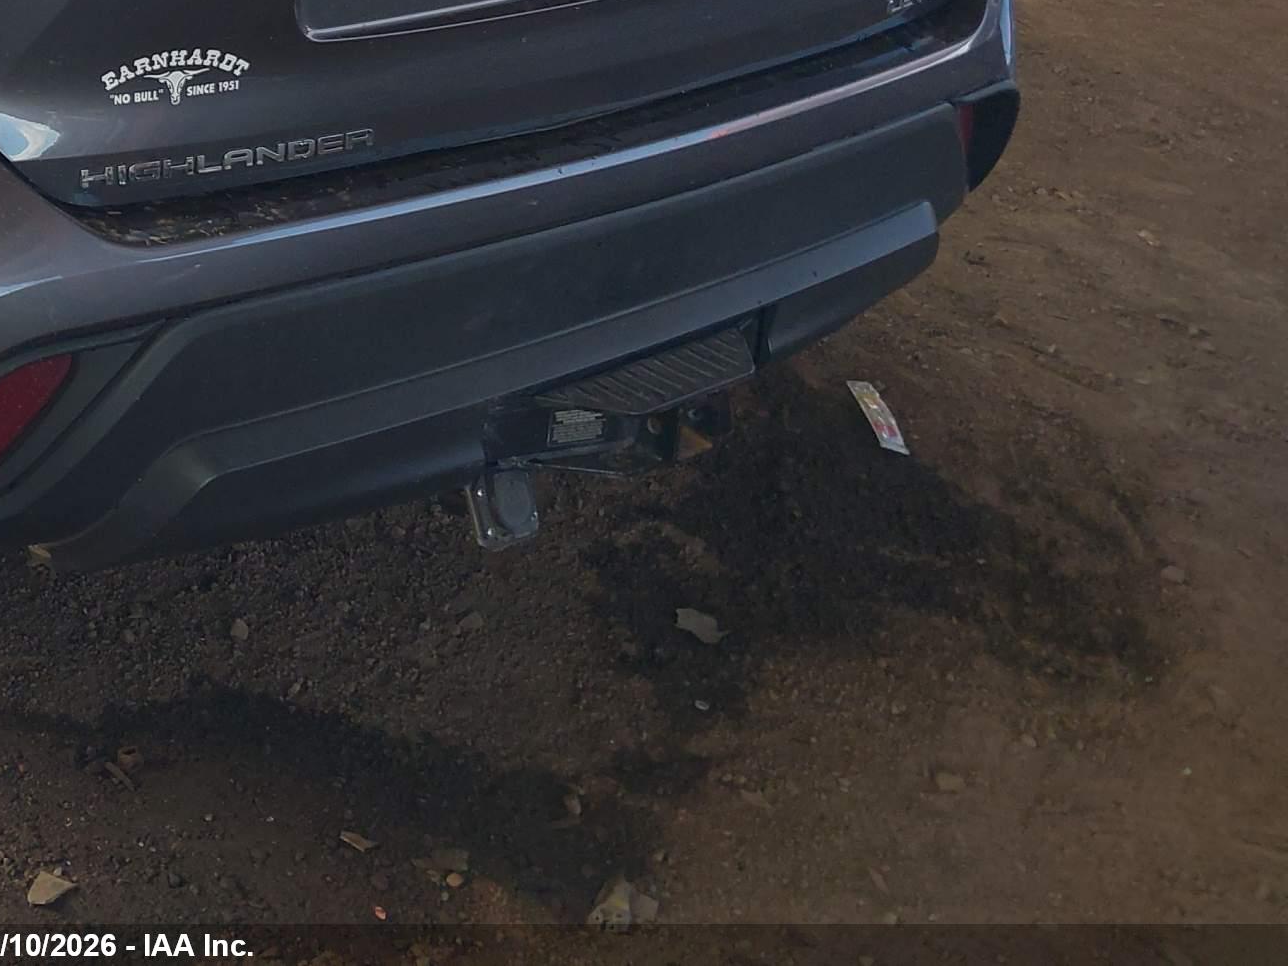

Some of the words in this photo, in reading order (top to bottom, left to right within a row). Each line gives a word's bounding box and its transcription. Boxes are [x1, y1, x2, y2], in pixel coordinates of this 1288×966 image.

[101, 48, 250, 90] EARNHARDT
[187, 83, 214, 96] SINCE
[219, 80, 239, 92] 1951
[80, 128, 374, 188] HIGHLANDER
